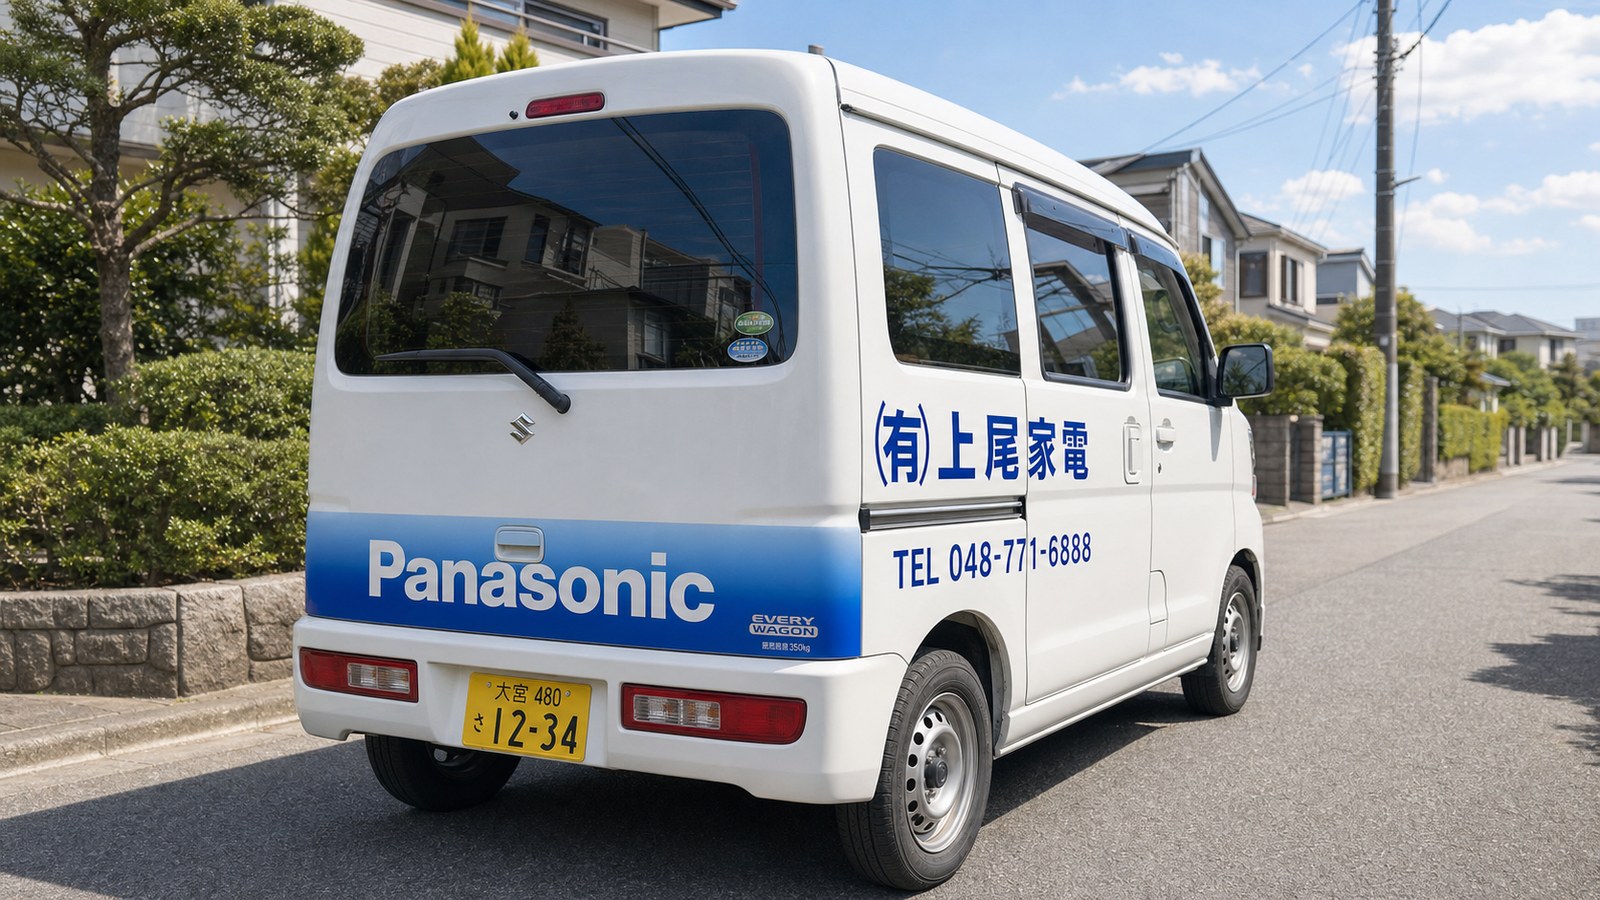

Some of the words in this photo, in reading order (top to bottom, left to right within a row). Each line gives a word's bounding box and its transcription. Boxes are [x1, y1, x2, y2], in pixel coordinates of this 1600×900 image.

[893, 547, 940, 589] TEL
[949, 532, 1092, 582] 048-771-6888
[369, 539, 716, 623] Panasonic
[752, 614, 815, 626] EVERY
[752, 625, 815, 636] WAGON
[495, 682, 528, 704] 大宮
[534, 686, 562, 707] 480
[473, 713, 484, 733] さ
[493, 707, 578, 755] 12-34
